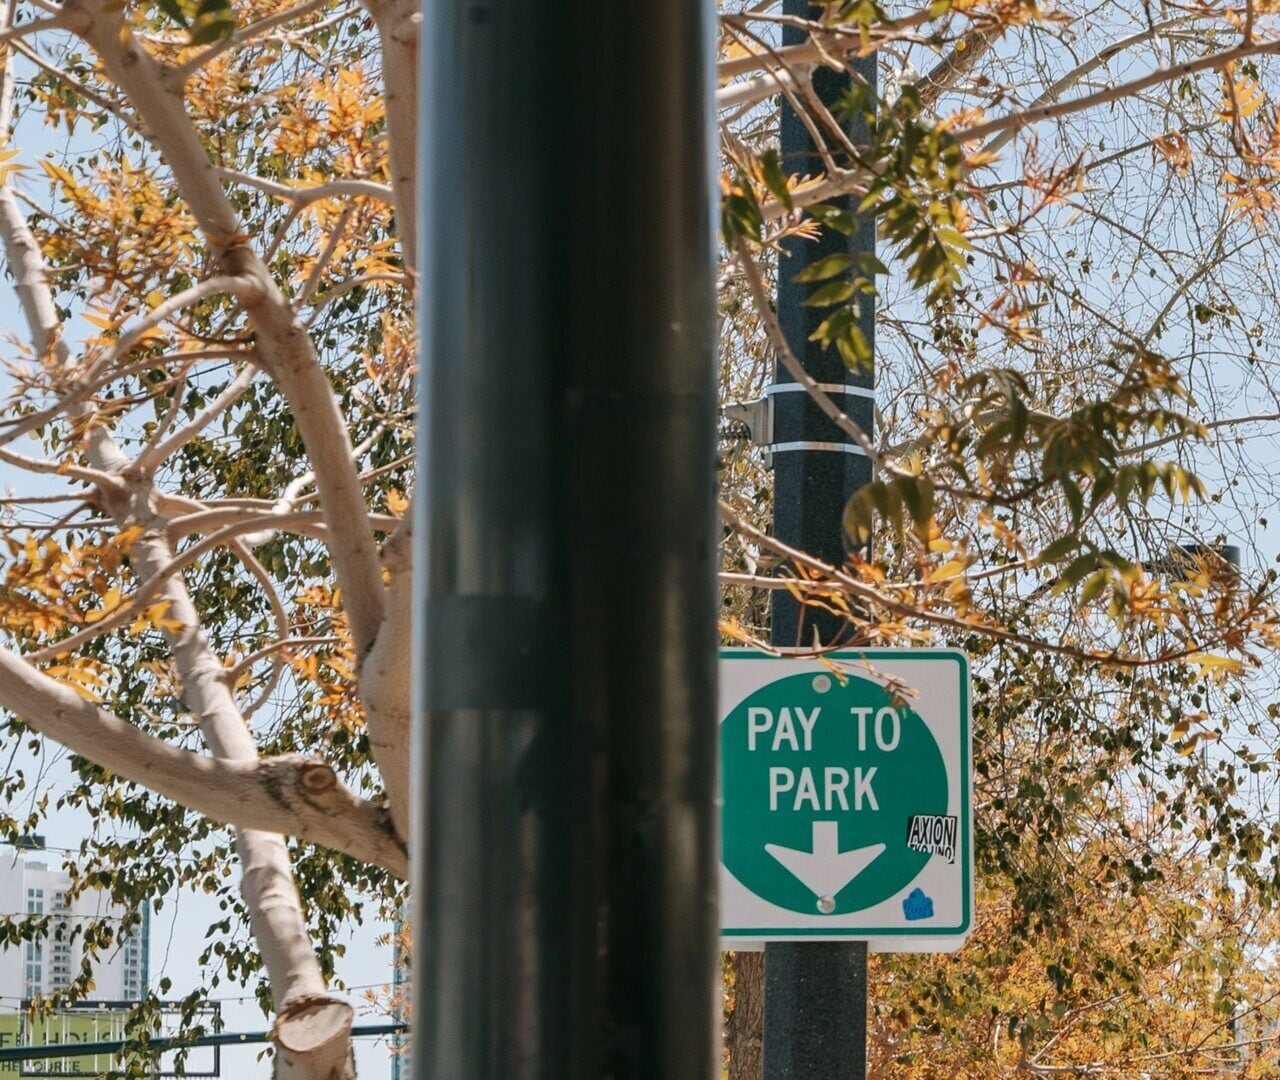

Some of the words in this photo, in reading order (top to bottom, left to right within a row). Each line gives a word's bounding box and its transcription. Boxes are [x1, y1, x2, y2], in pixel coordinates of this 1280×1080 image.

[747, 706, 821, 752] PAY
[850, 706, 901, 752] TO
[769, 766, 879, 811] PARK
[910, 815, 955, 847] AXION
